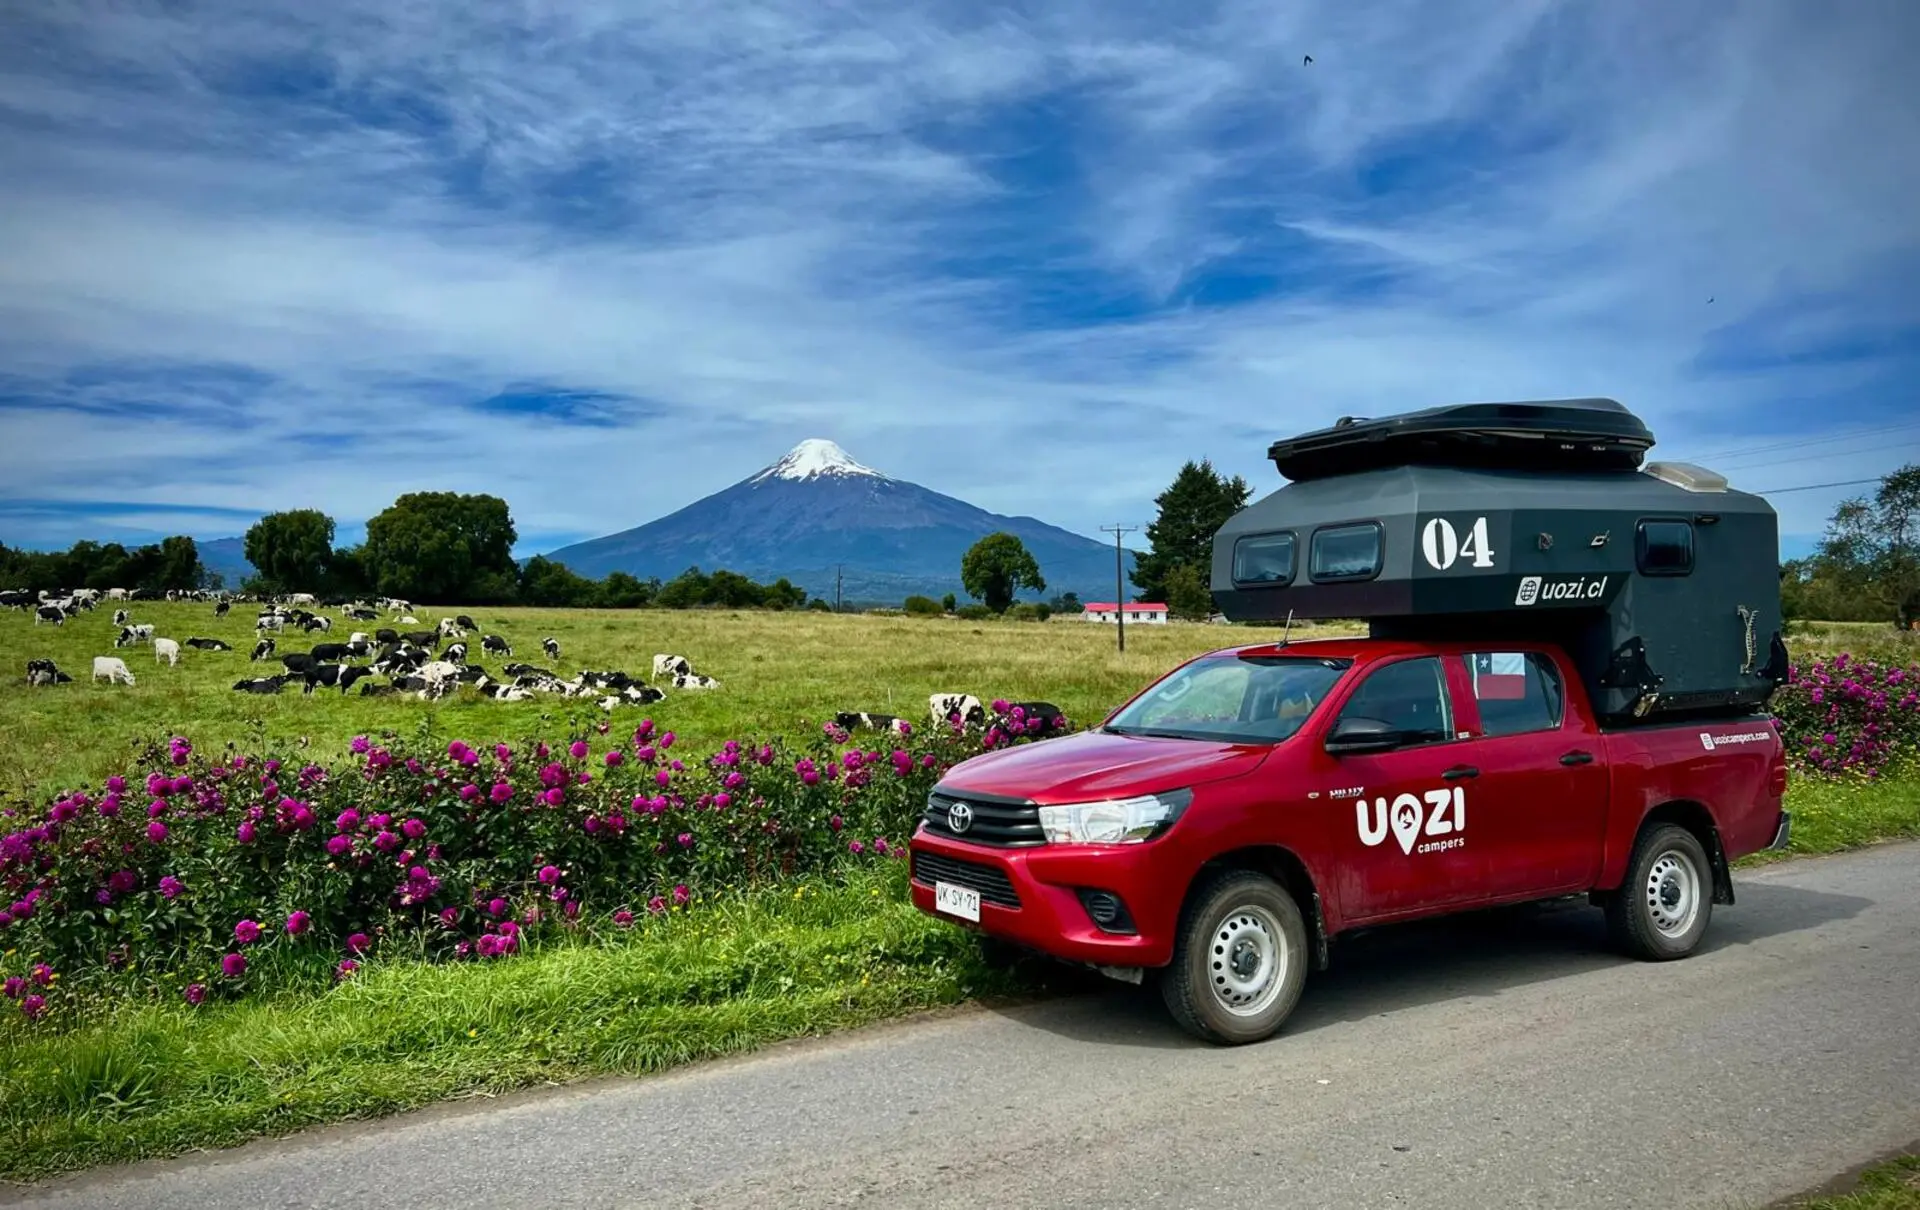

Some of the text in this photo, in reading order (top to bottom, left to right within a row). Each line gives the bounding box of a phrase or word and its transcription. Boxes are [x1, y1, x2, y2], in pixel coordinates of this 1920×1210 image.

[1422, 517, 1495, 570] 04
[1541, 576, 1608, 600] uozi.cl
[1418, 837, 1465, 854] campers
